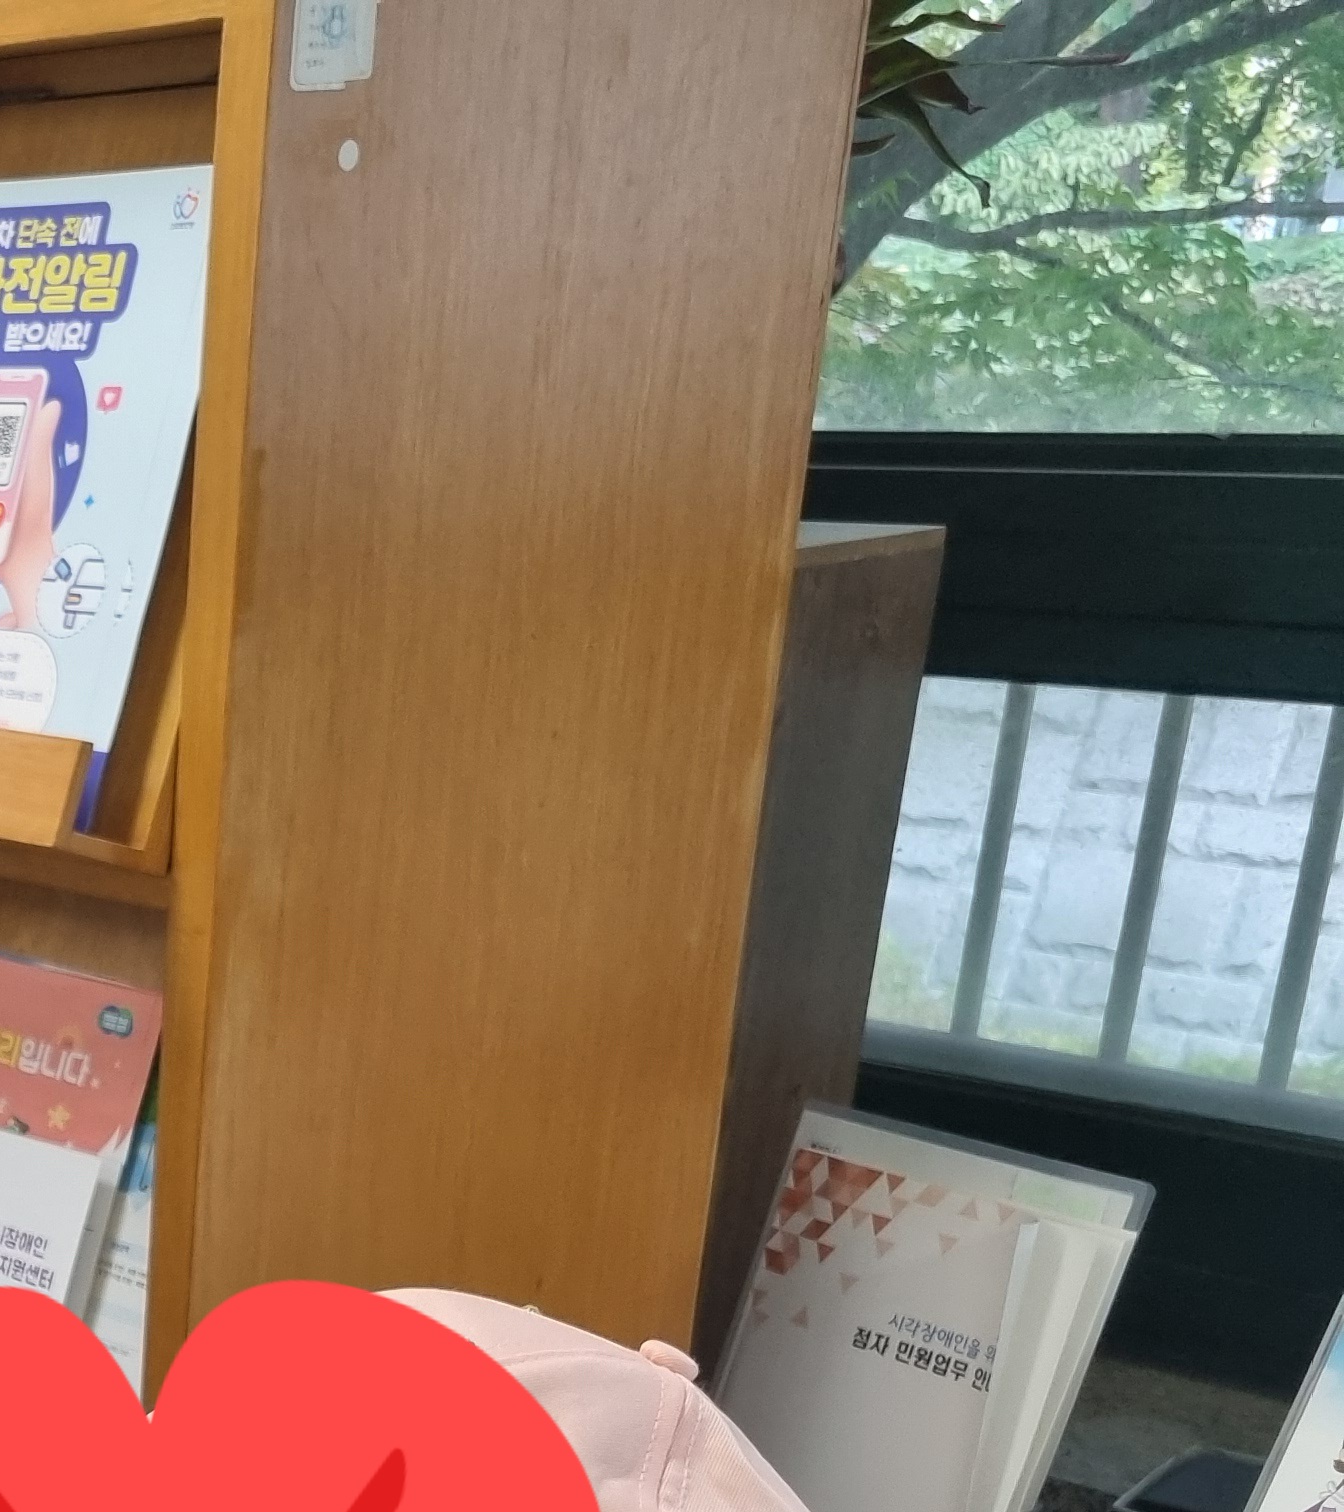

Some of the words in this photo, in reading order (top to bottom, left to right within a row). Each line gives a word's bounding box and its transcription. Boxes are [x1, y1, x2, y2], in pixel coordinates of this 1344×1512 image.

[15, 217, 58, 250] 단속
[59, 214, 105, 248] 전에
[3, 320, 95, 353] 받으세요!
[851, 1325, 891, 1357] 점자
[894, 1339, 969, 1382] 민원업무
[888, 1312, 981, 1359] 시각장애인을
